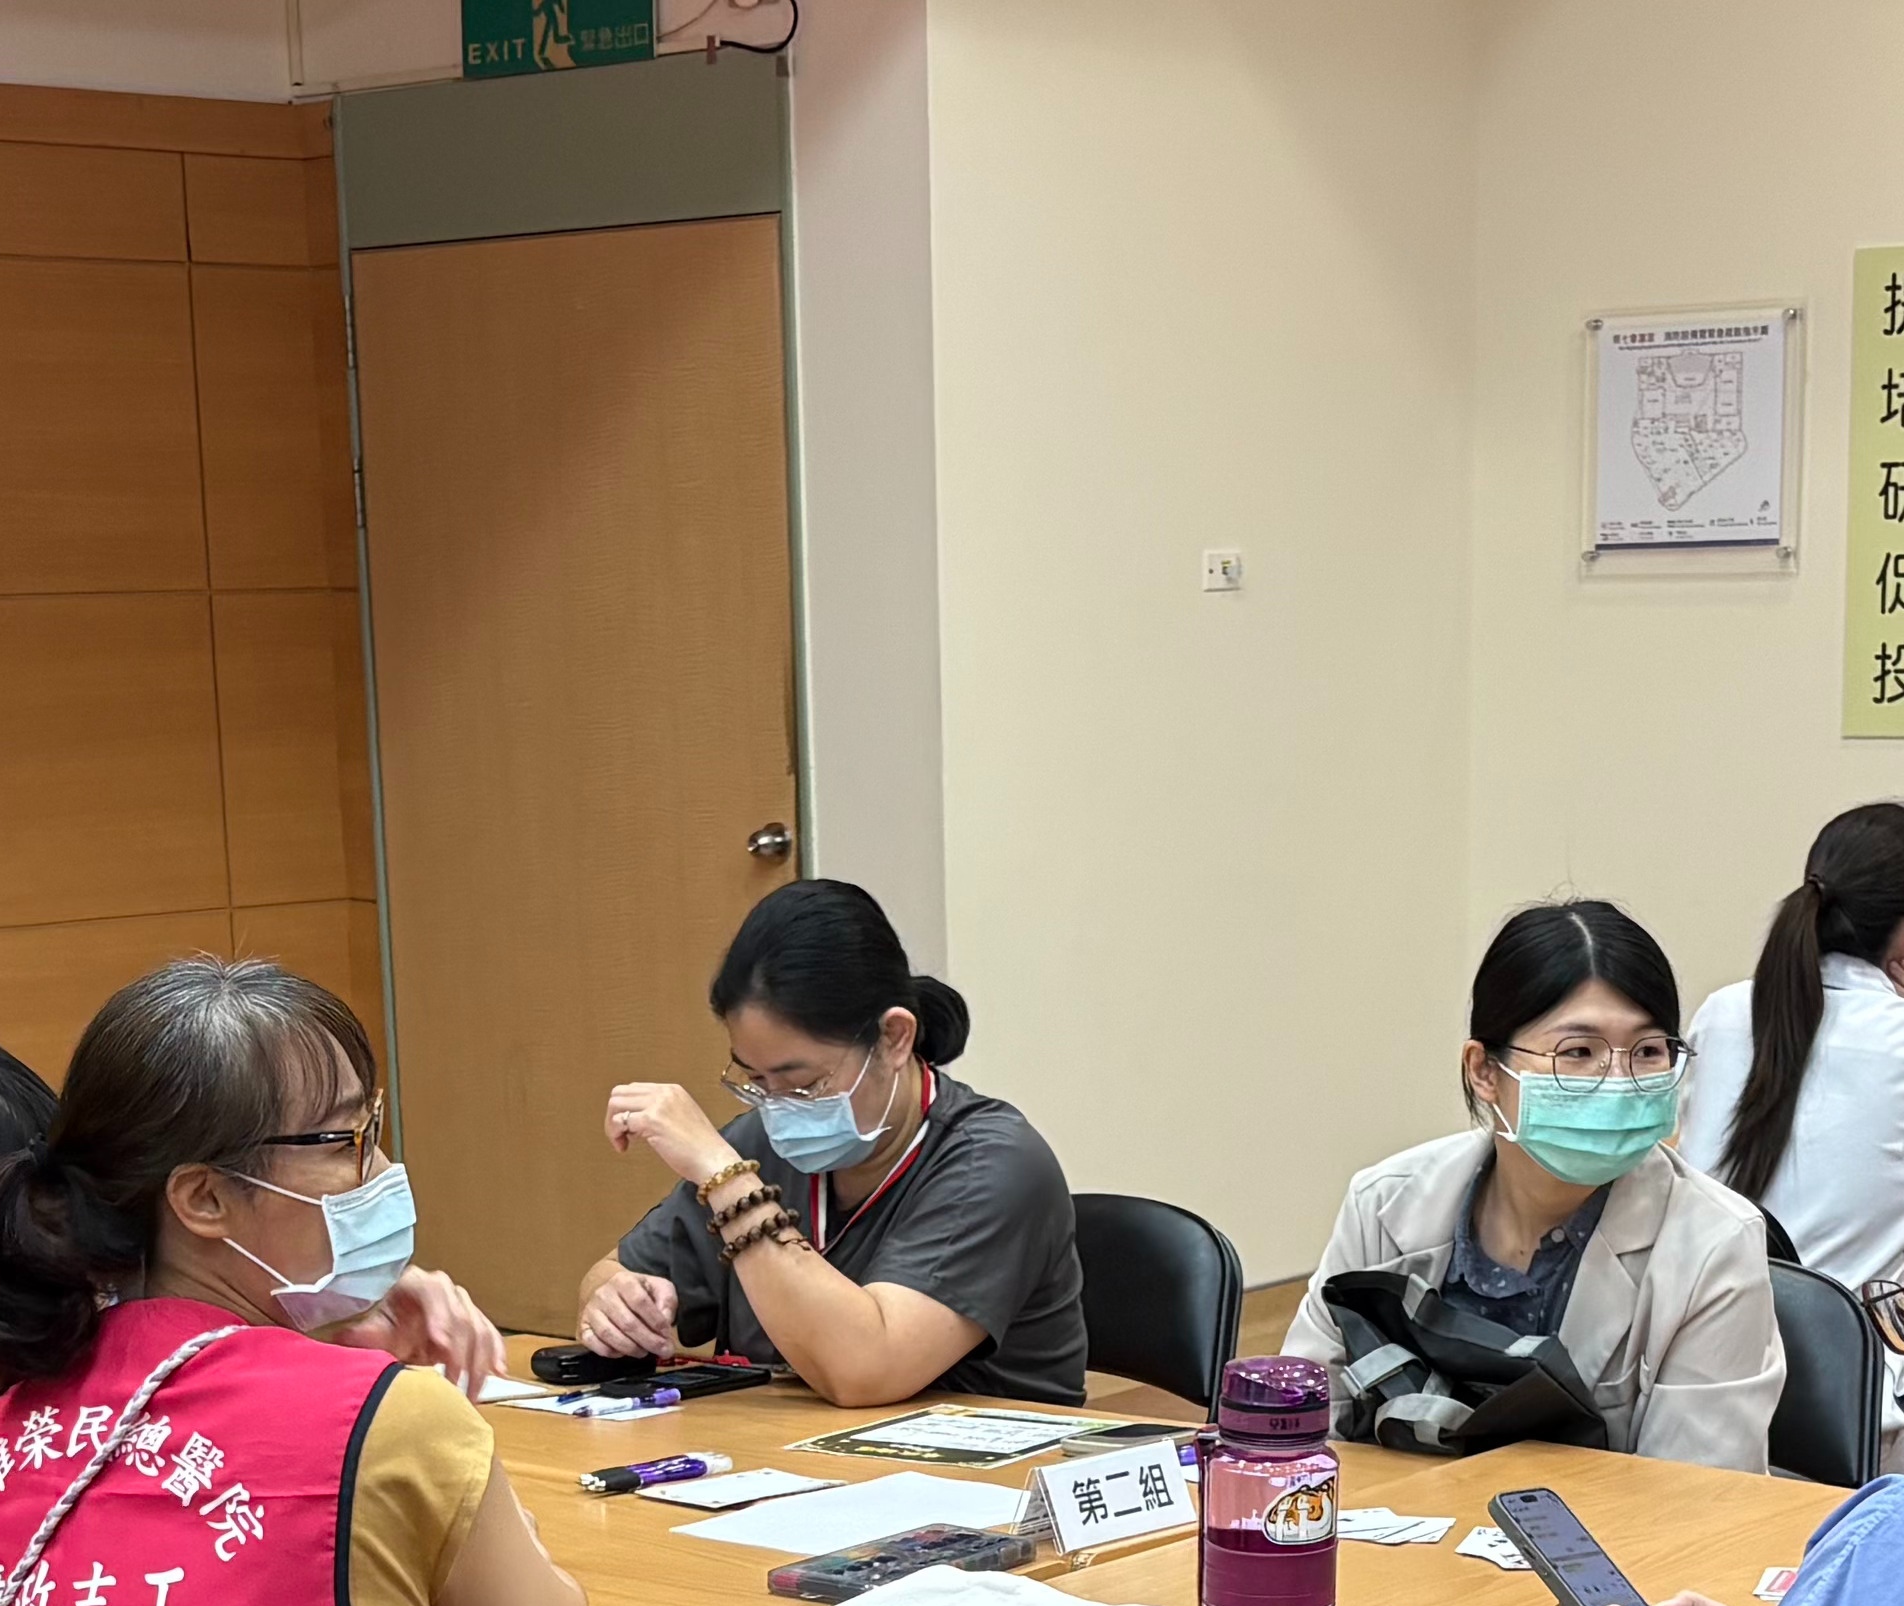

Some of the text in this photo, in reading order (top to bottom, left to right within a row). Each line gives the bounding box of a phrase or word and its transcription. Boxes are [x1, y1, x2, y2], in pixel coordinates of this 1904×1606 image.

[468, 38, 525, 65] EXIT
[580, 23, 650, 52] 緊急出口
[1071, 1463, 1175, 1526] 第二組
